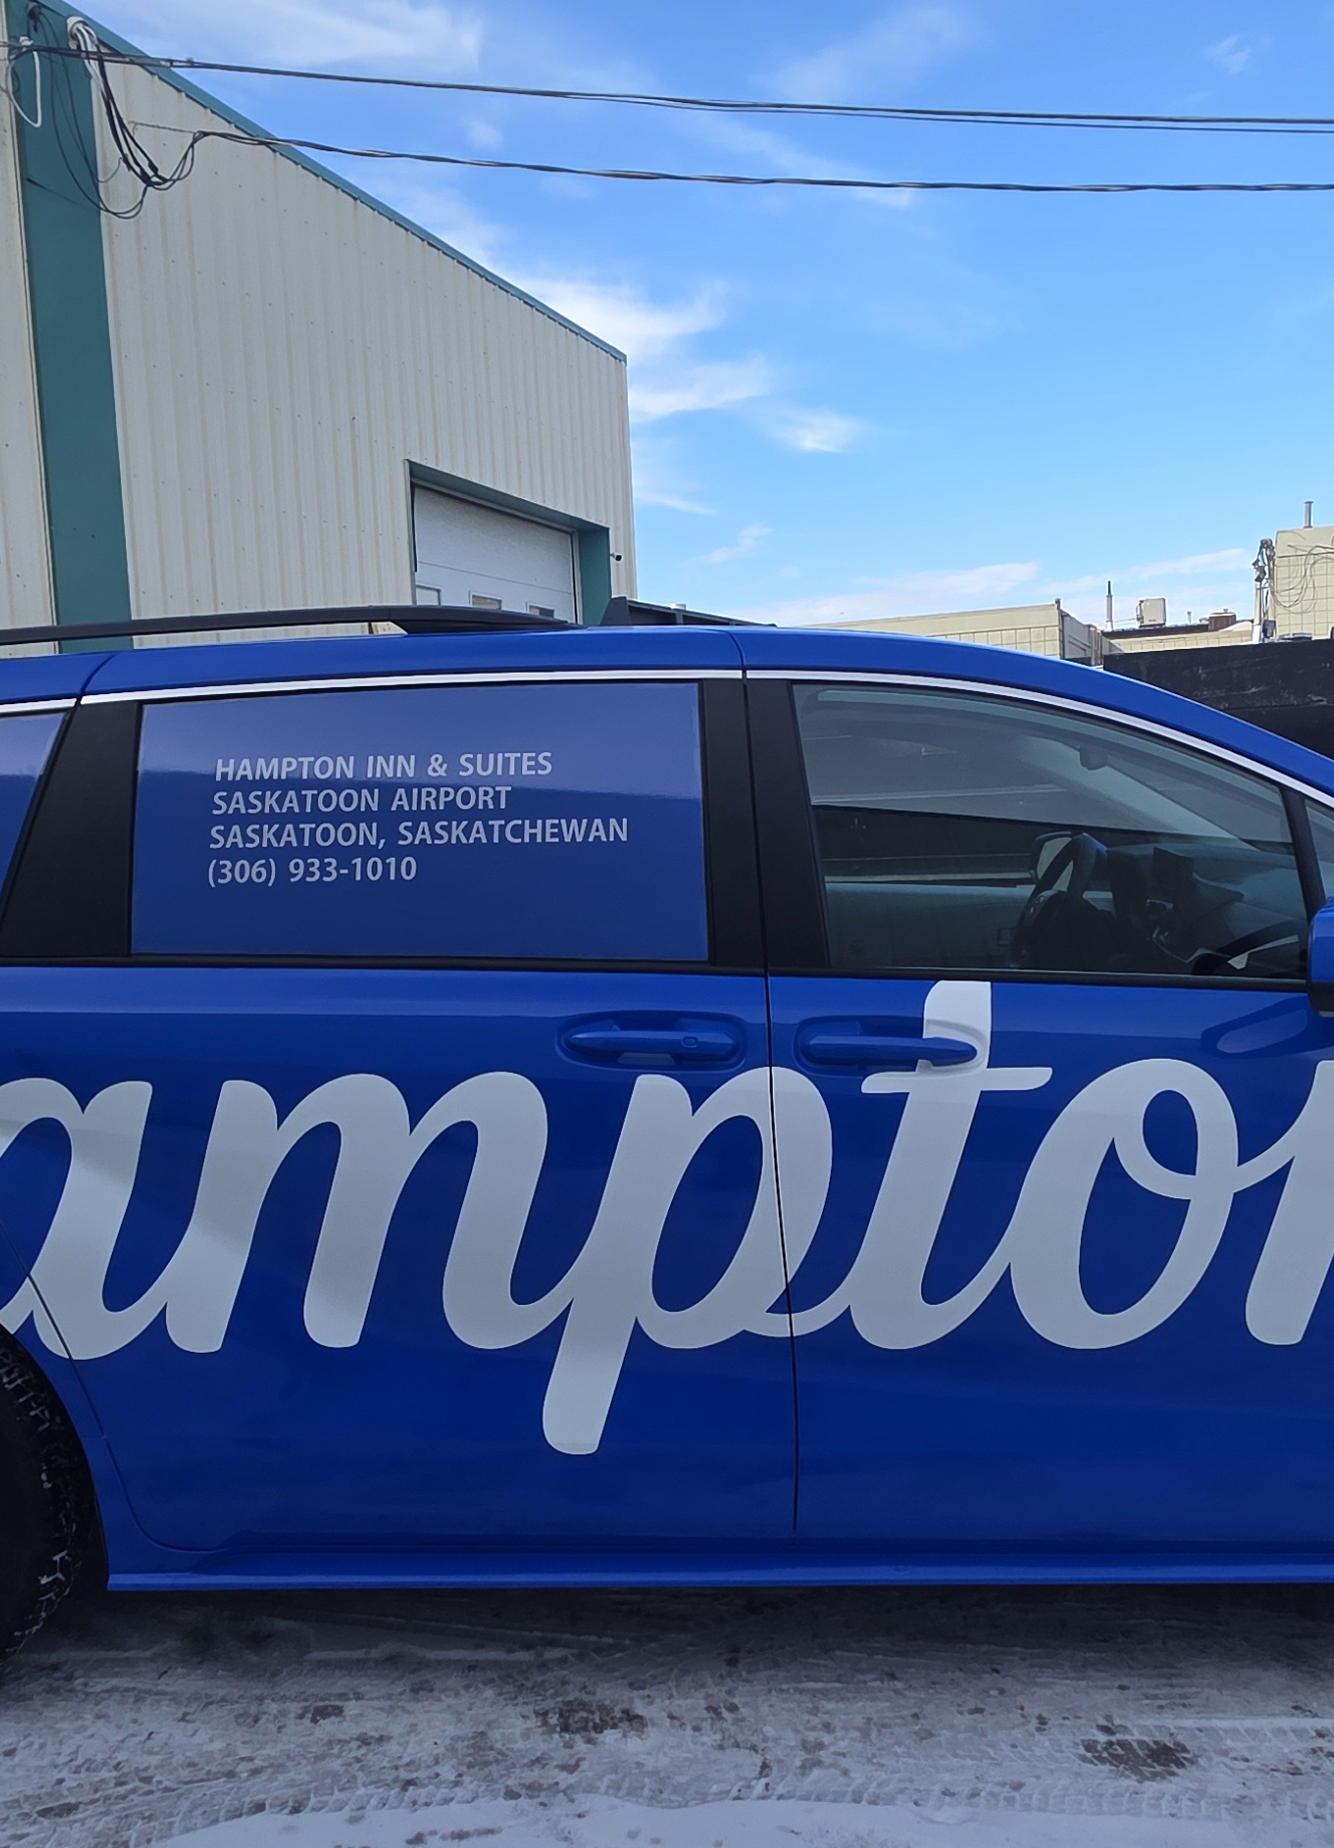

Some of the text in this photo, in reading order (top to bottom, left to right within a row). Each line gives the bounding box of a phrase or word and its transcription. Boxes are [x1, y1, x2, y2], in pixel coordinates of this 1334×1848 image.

[215, 751, 553, 782] HAMPTON INN & SUITES
[211, 785, 512, 815] SASKATOON AIRPORT
[209, 817, 629, 850] SASKATOON, SASKATCHEWAN
[207, 855, 417, 888] (306) 933-1010
